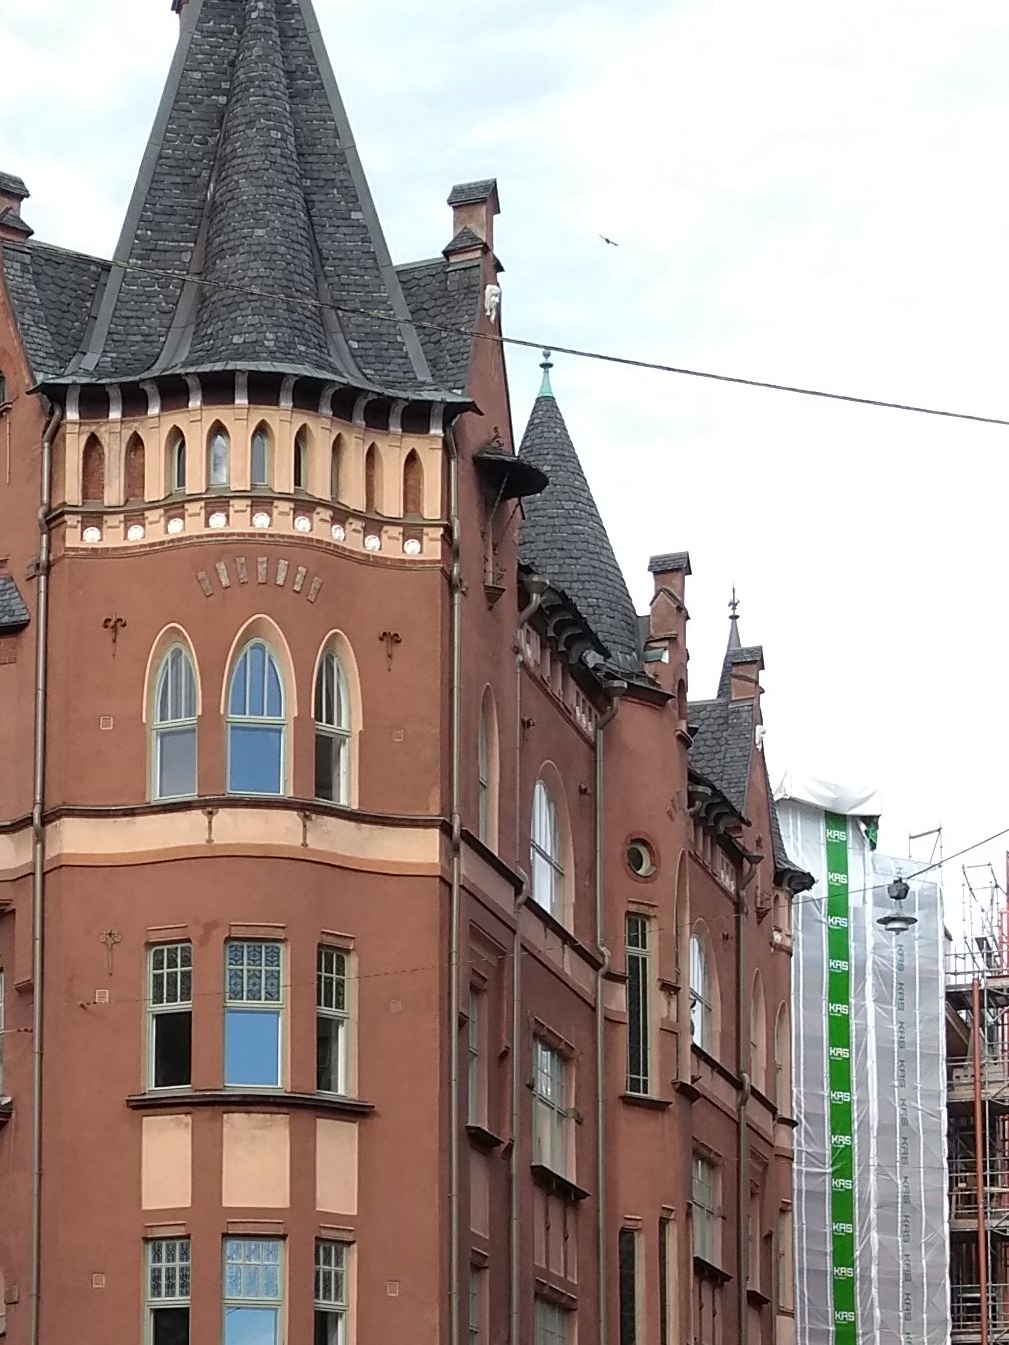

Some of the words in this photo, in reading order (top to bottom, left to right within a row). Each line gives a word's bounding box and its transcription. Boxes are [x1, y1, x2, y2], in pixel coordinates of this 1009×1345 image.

[827, 829, 846, 840] KAS
[828, 872, 847, 884] KAS
[828, 915, 847, 927] KAS
[829, 959, 848, 970] KAS
[829, 1003, 849, 1014] KAS
[830, 1047, 849, 1058] KAS
[830, 1091, 850, 1102] KAS
[832, 1135, 851, 1145] KAS
[901, 1137, 909, 1164] KAS
[832, 1179, 852, 1188] KAS
[833, 1223, 852, 1232] KAS
[834, 1266, 853, 1277] KAS
[835, 1311, 854, 1321] KAS
